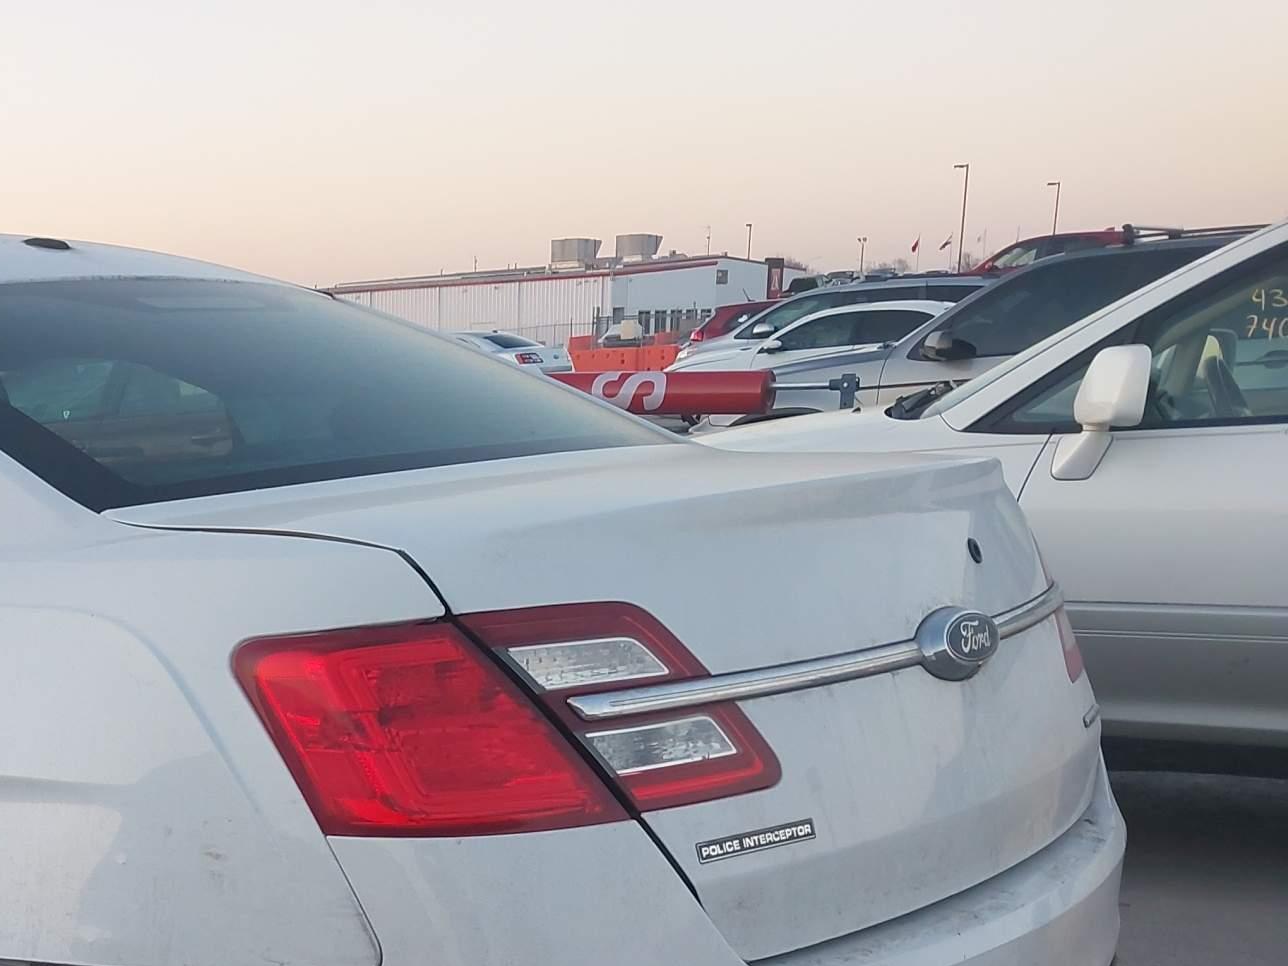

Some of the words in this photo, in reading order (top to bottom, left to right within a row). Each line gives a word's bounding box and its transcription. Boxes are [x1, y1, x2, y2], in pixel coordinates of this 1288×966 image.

[960, 619, 991, 654] Ford
[700, 839, 742, 859] POLICE
[742, 823, 813, 849] INTERCEPTOR
